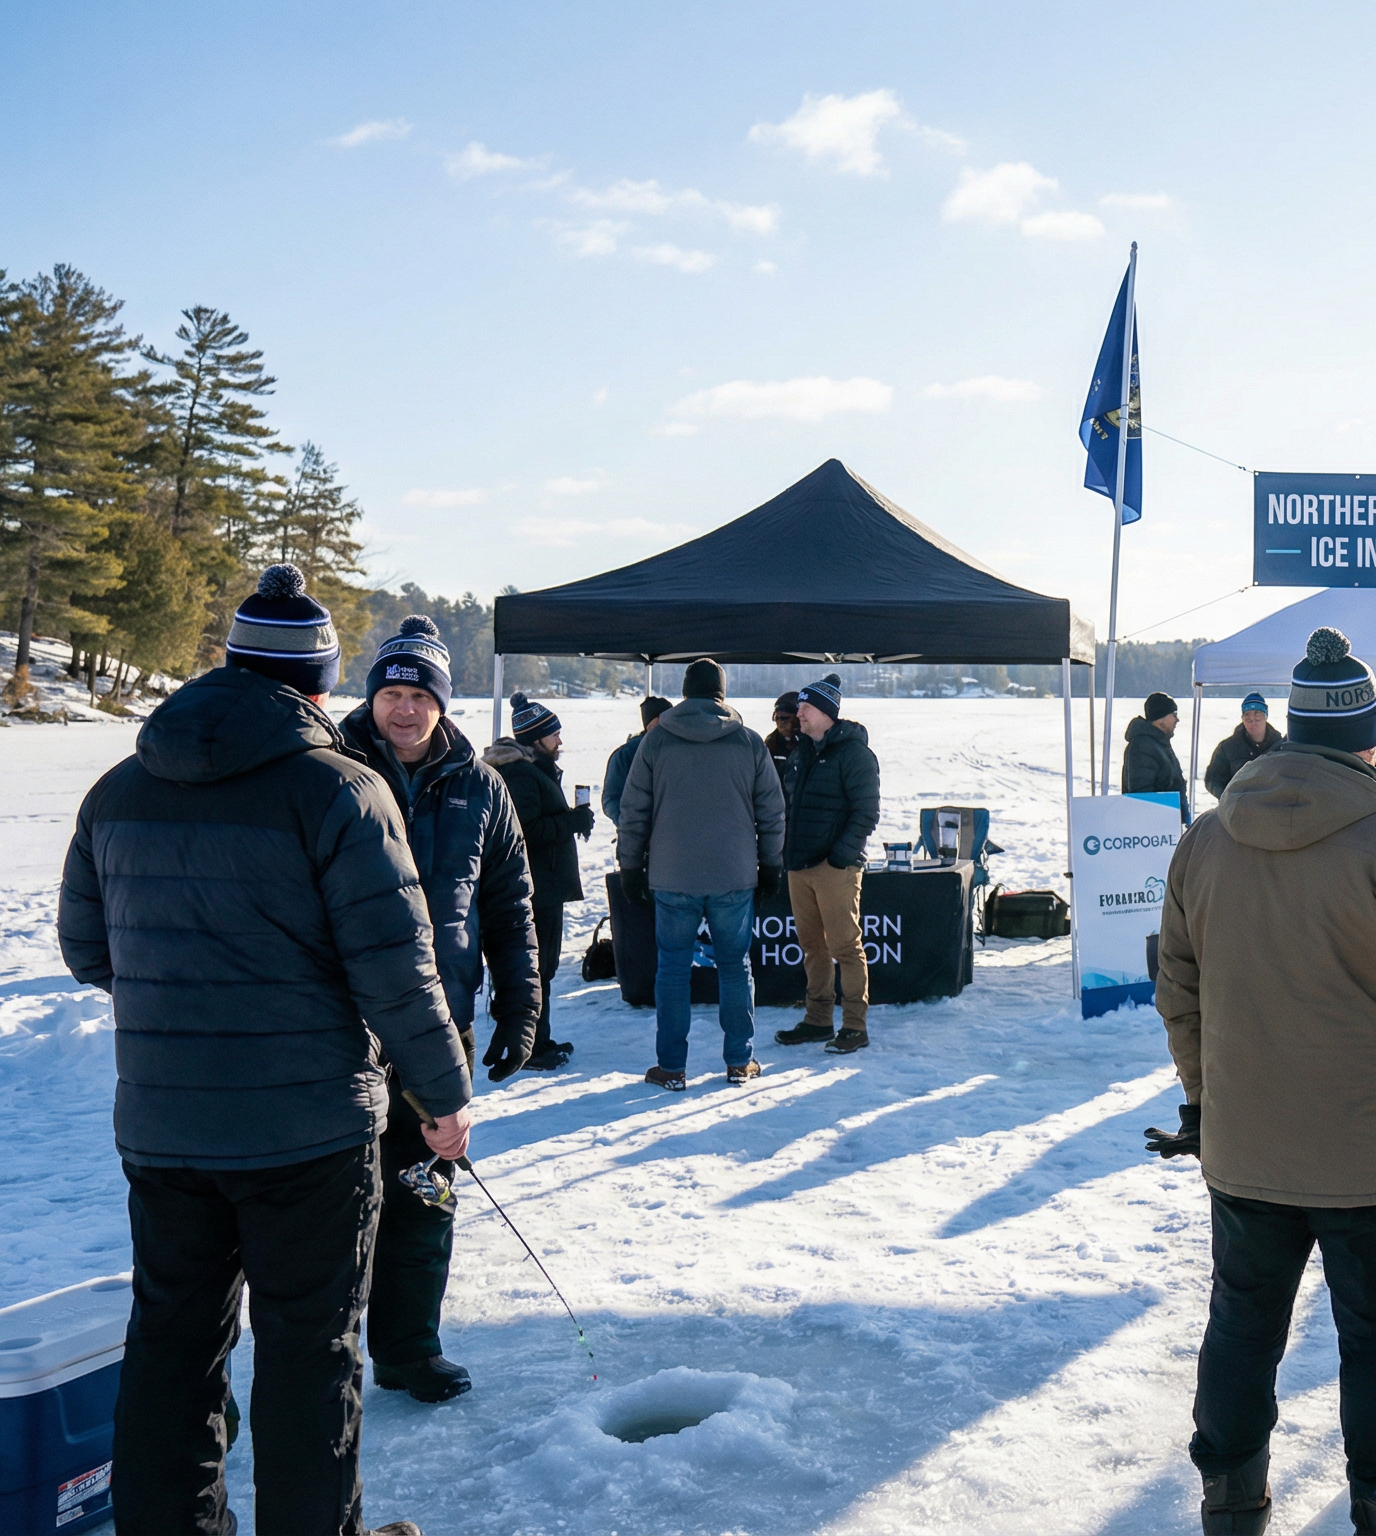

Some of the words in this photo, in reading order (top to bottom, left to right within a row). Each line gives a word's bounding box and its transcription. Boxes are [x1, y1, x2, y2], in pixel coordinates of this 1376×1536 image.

[1311, 536, 1349, 567] ICE
[752, 914, 901, 938] NORRN
[761, 942, 902, 966] HOON
